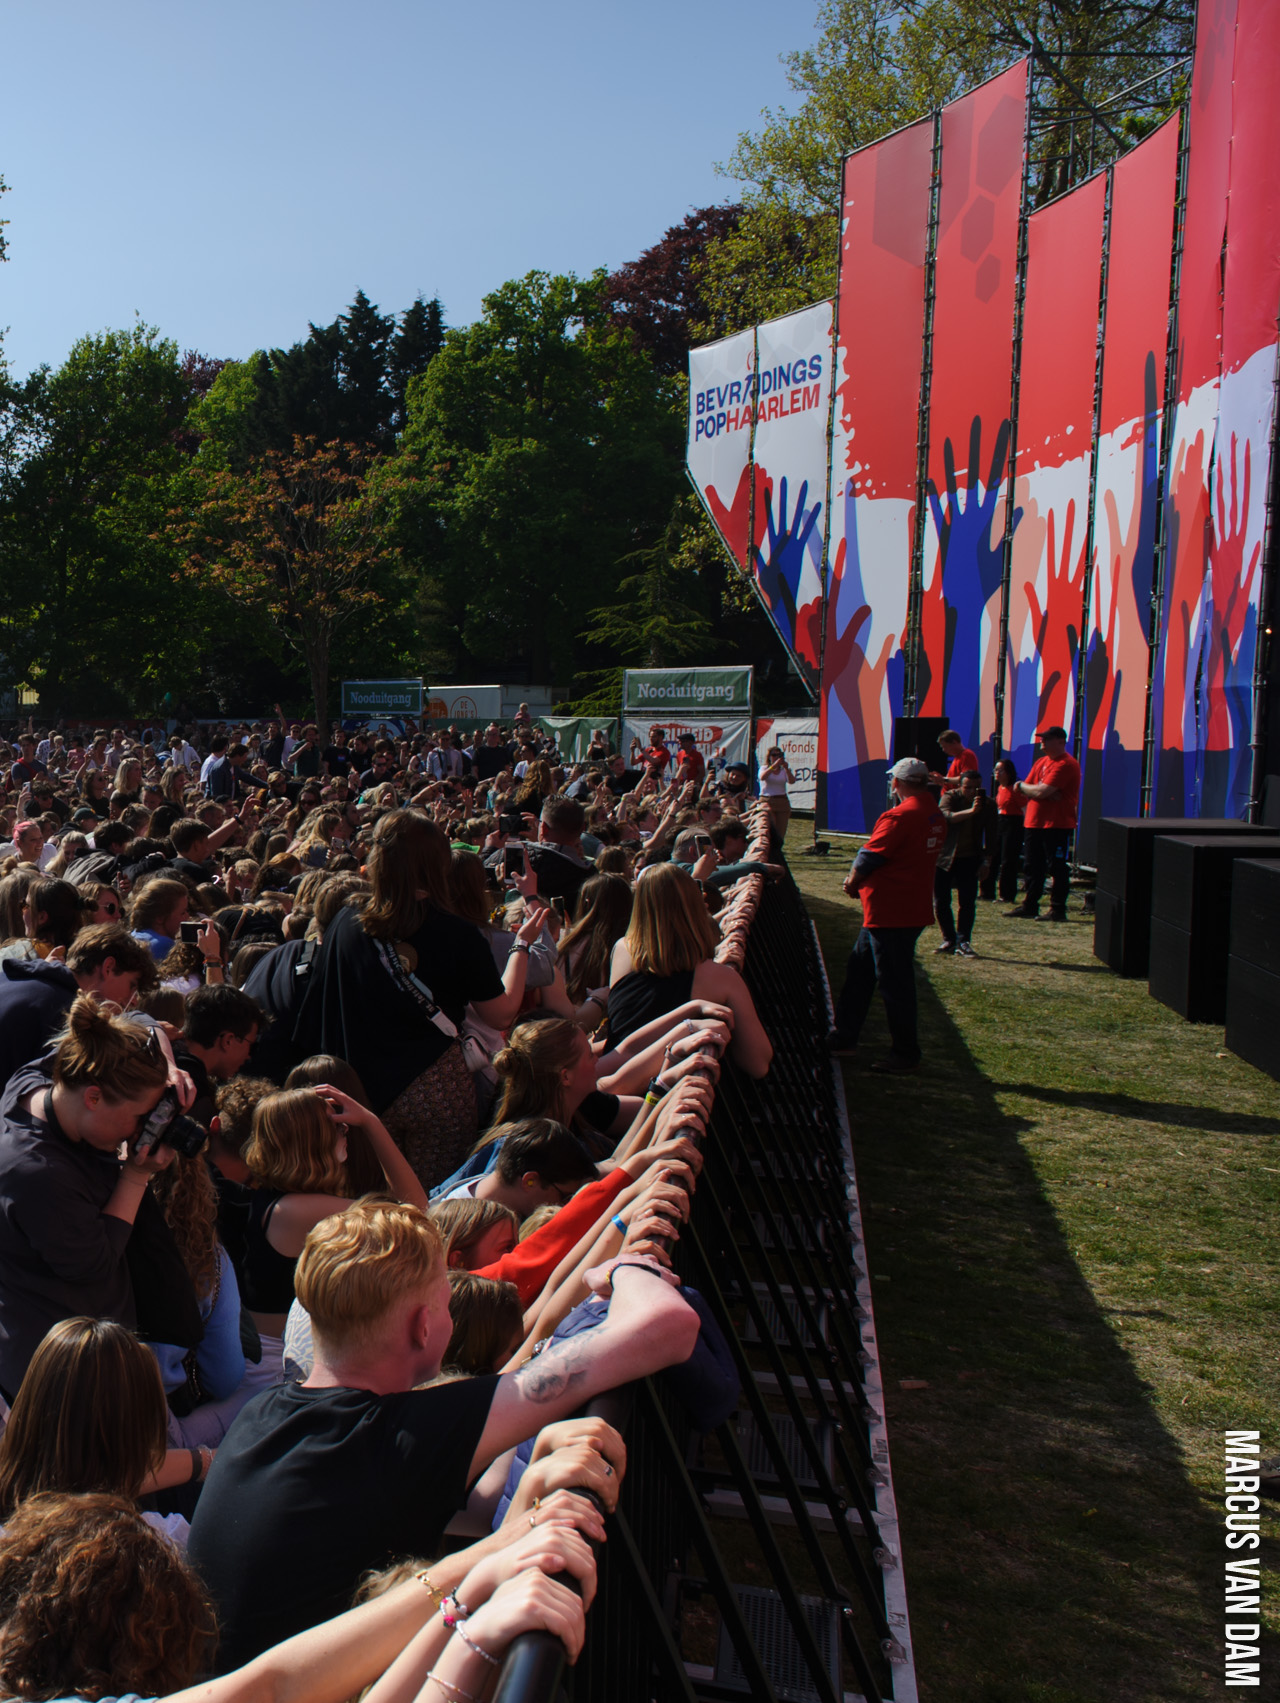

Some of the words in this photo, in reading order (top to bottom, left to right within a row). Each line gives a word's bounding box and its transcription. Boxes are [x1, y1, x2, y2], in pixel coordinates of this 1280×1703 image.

[695, 383, 821, 442] POPHAARLEM
[350, 691, 412, 708] Nooduitgang
[637, 682, 735, 702] Nooduitgang
[781, 740, 815, 753] vfonds
[794, 767, 818, 782] EDE
